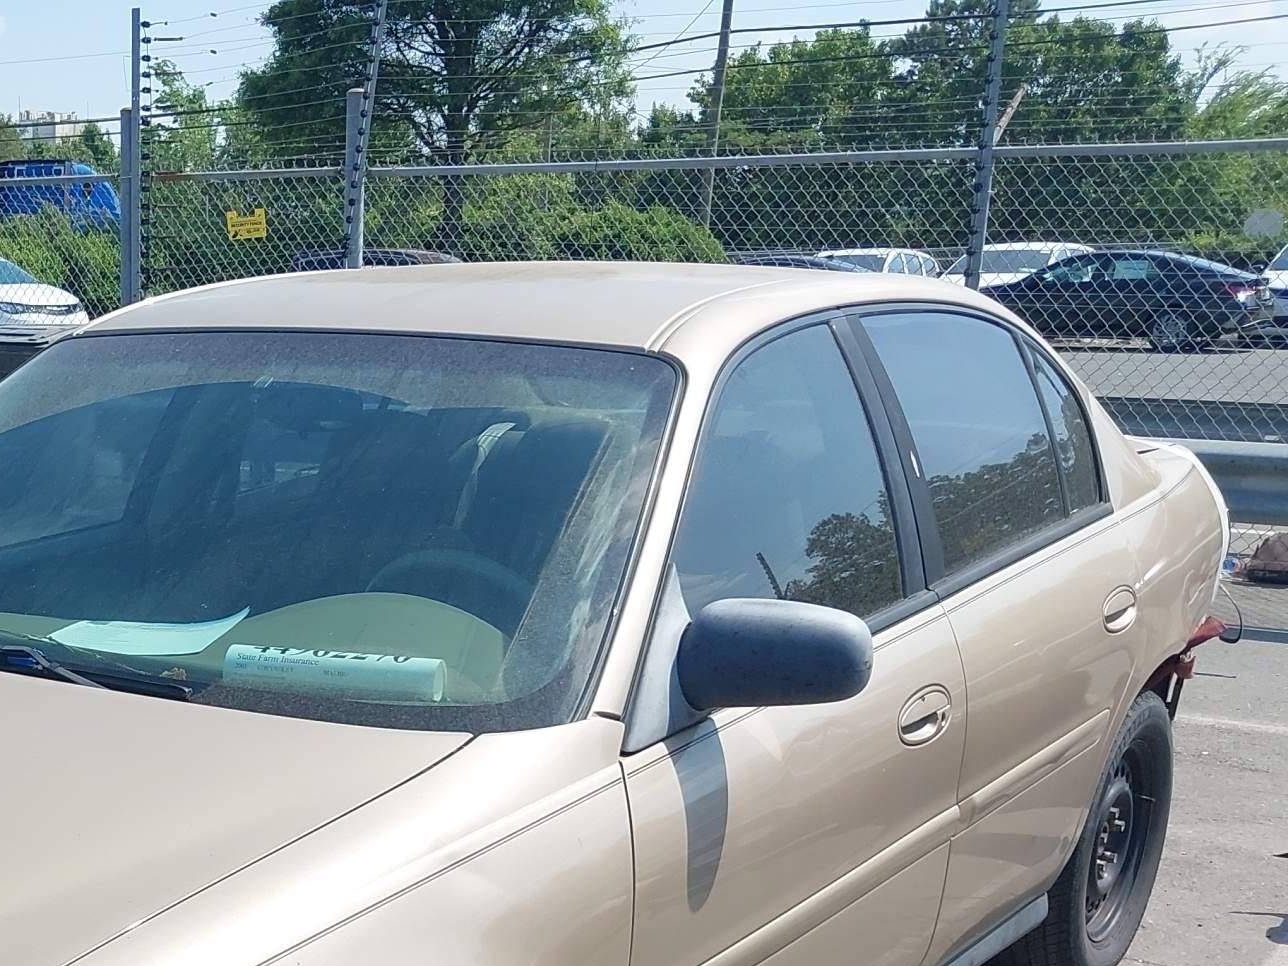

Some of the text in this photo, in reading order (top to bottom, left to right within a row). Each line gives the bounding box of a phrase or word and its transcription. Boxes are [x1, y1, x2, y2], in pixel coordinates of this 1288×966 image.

[237, 653, 320, 666] State Farm Insurance
